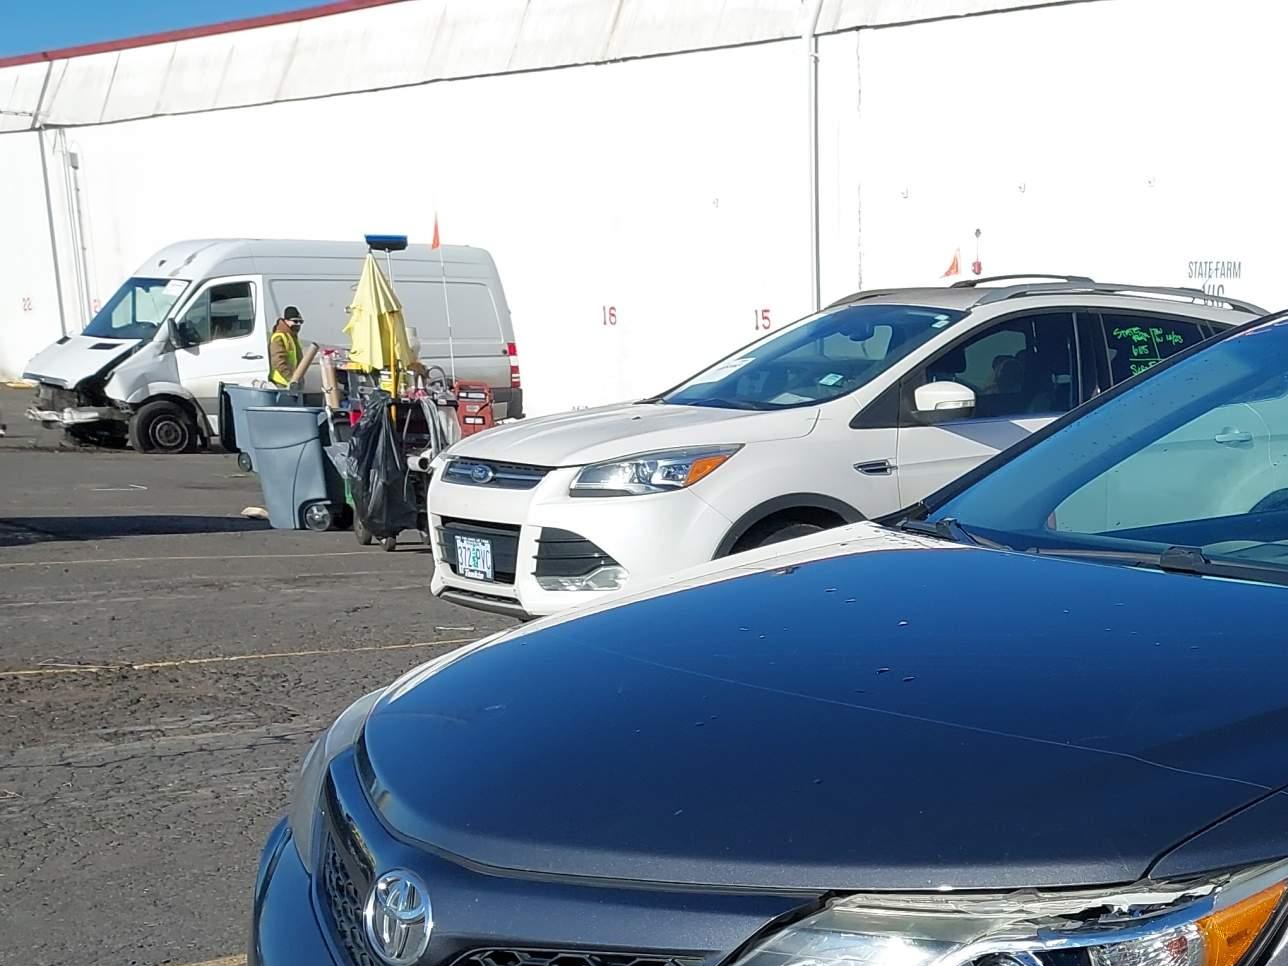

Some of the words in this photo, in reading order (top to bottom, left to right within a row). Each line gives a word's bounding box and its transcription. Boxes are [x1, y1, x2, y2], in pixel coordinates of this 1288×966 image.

[1188, 261, 1213, 279] STATE
[1215, 261, 1242, 279] FARM
[602, 305, 617, 326] 16
[754, 309, 771, 330] 15
